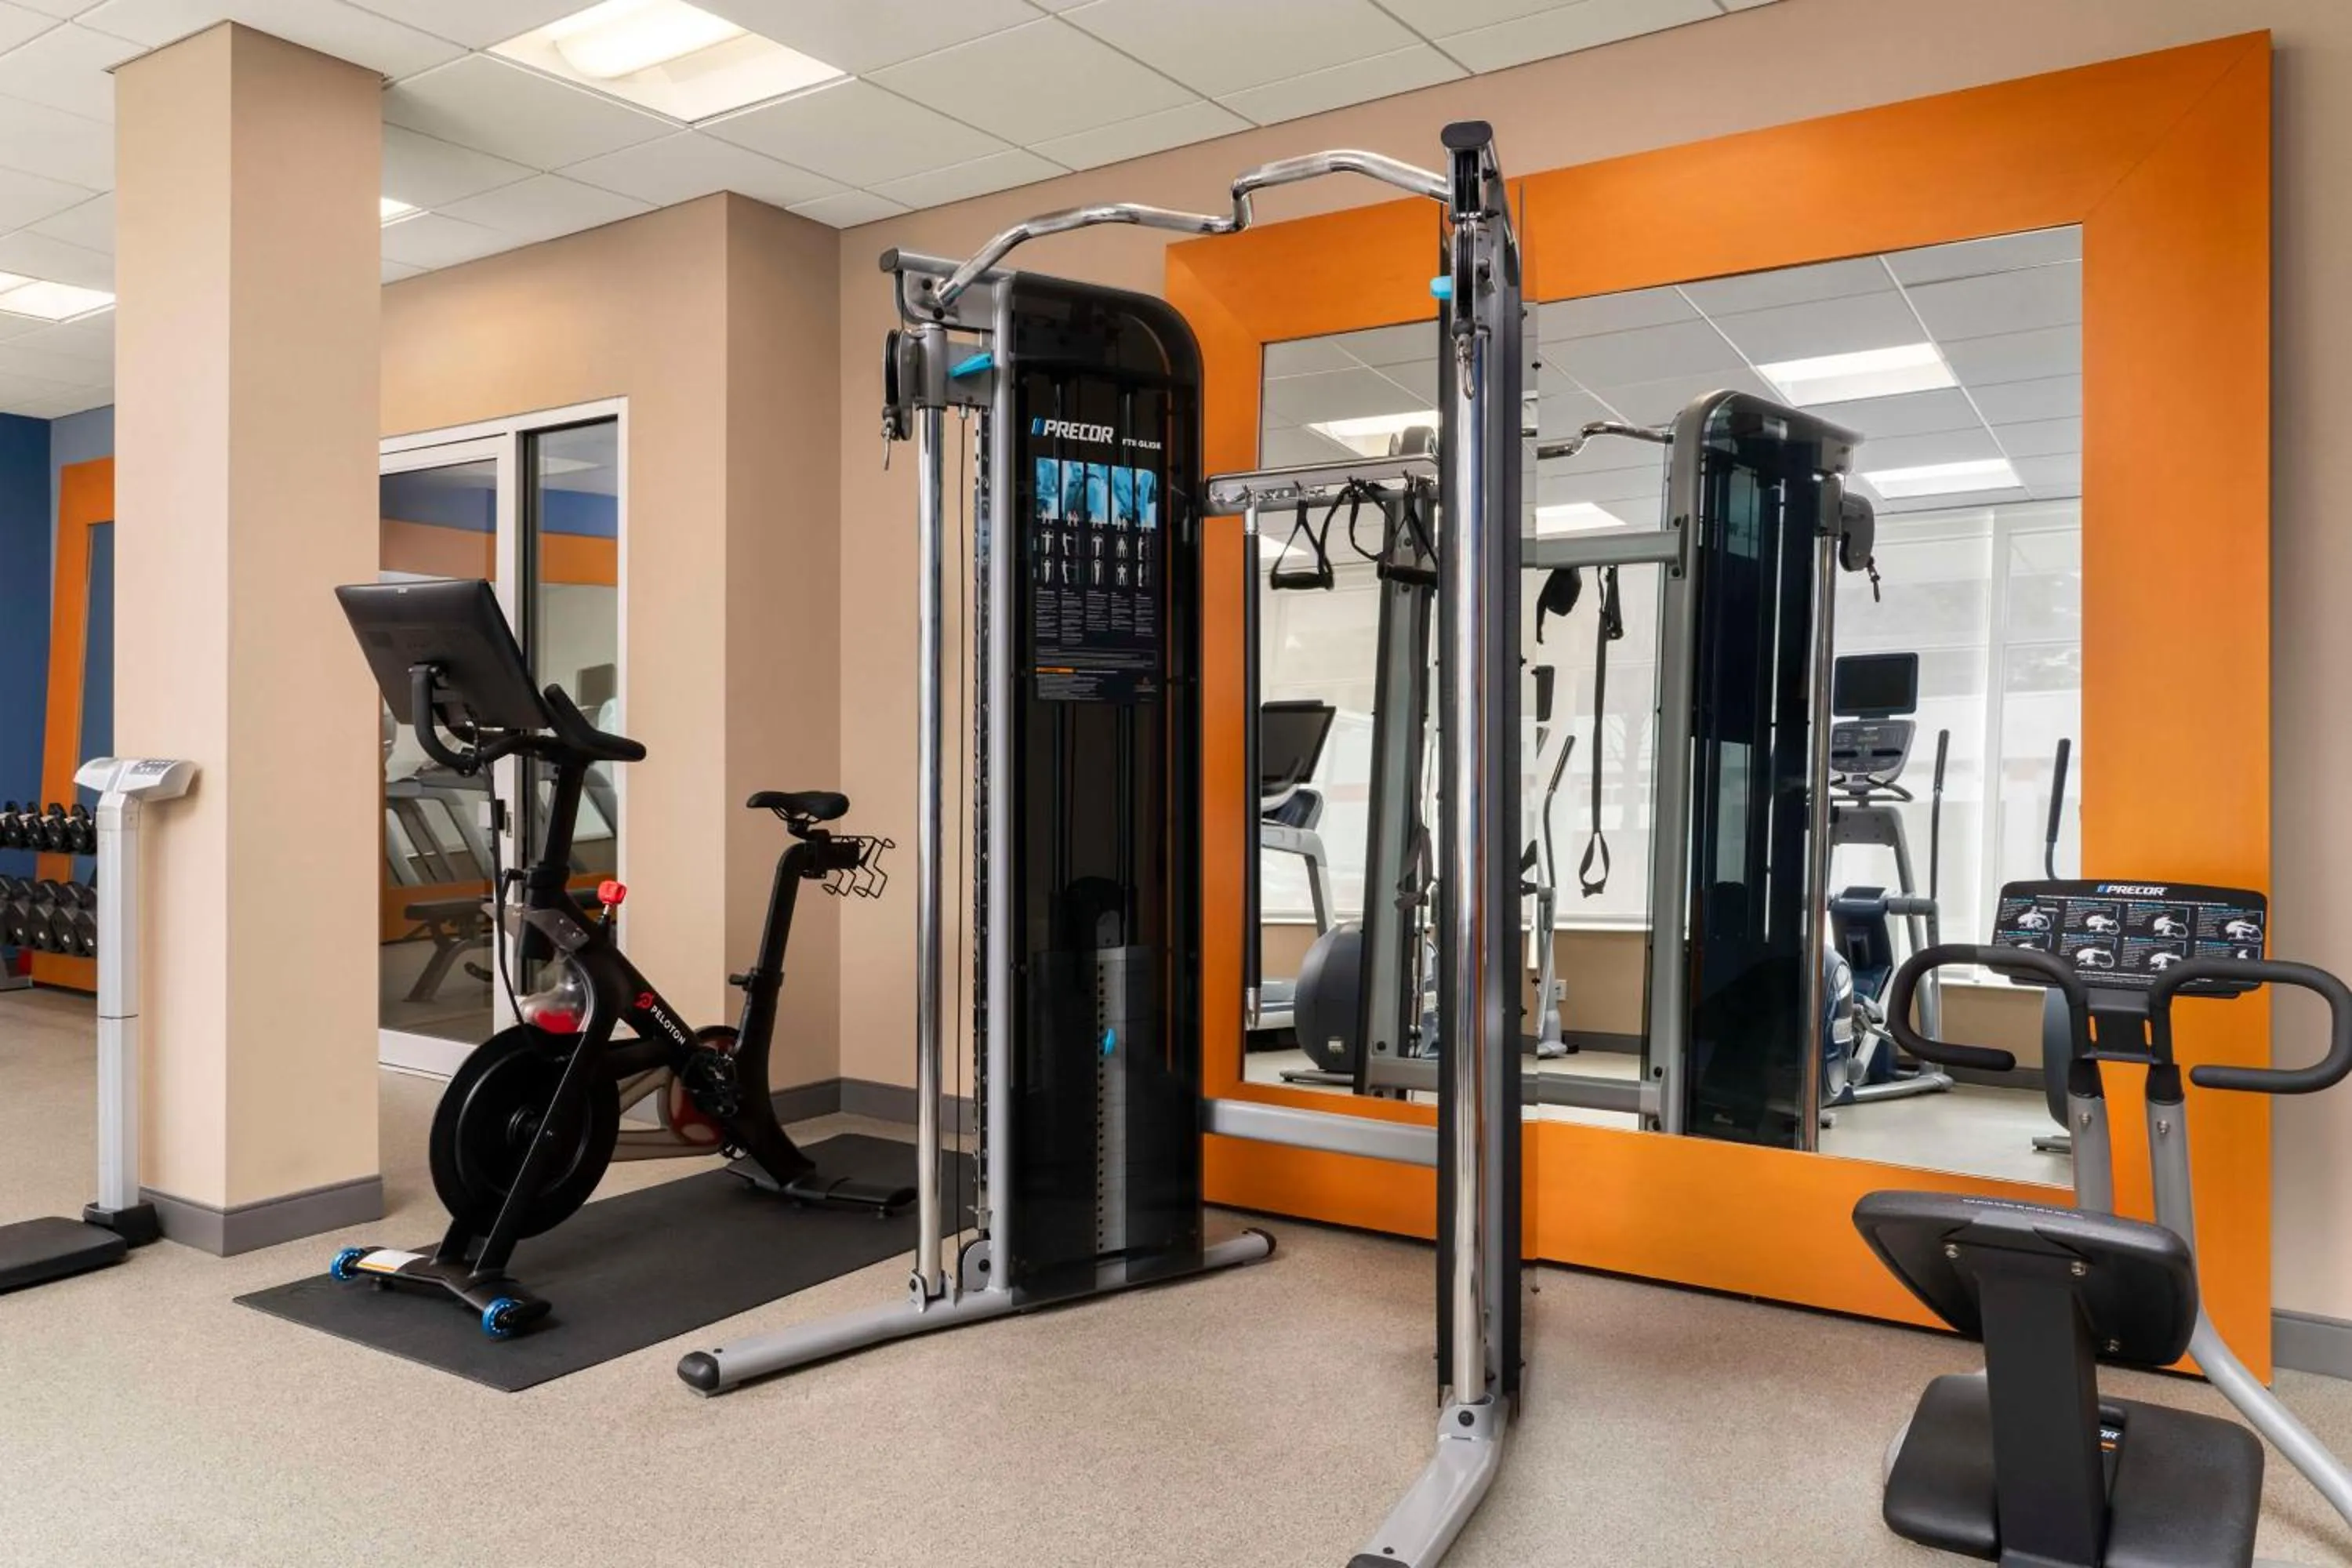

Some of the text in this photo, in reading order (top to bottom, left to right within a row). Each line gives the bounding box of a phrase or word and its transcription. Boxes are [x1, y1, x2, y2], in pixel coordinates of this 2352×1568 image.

[1044, 419, 1114, 444] PRECOR
[2107, 885, 2167, 896] PRECOR
[650, 1005, 687, 1045] PELOTON
